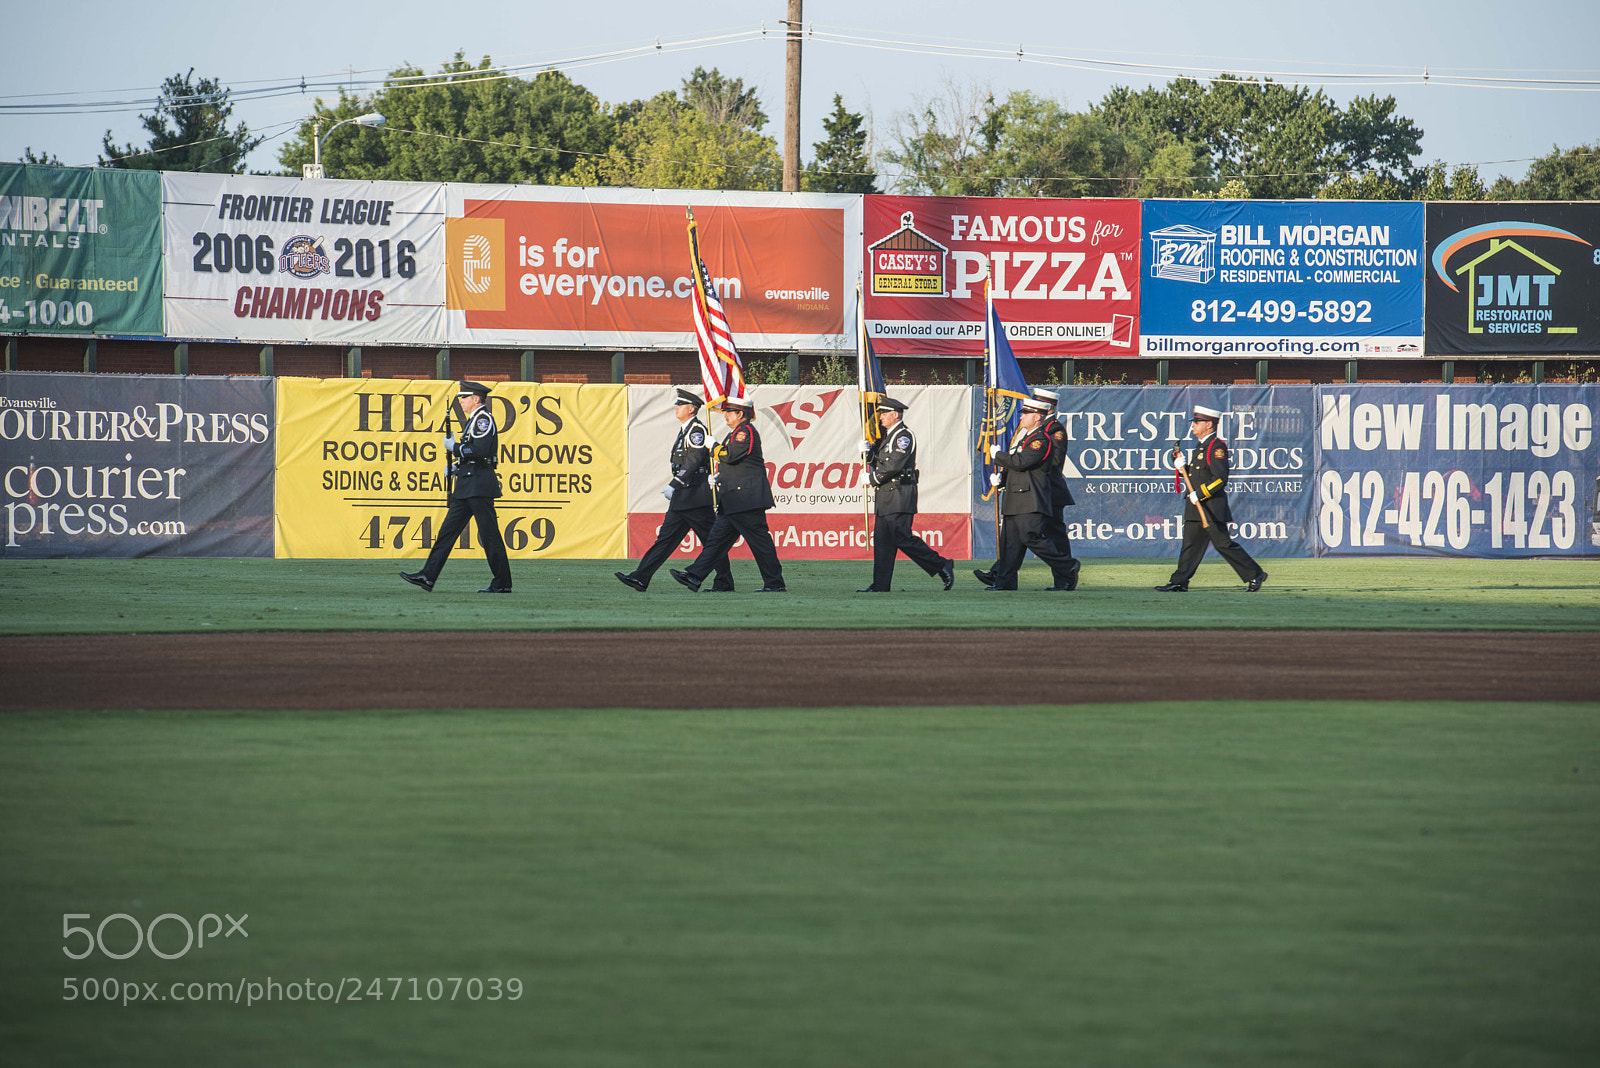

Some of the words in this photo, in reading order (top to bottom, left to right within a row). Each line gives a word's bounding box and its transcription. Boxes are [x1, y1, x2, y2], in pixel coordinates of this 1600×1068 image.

[218, 193, 314, 223] FRONTIER
[320, 199, 394, 226] LEAGUE
[951, 214, 1086, 243] FAMOUS
[1091, 219, 1123, 246] for
[1221, 224, 1271, 246] BILL
[1279, 224, 1390, 247] MORGAN
[193, 231, 275, 275] 2006
[278, 252, 331, 274] OTTERS
[334, 237, 416, 279] 2016
[519, 235, 544, 268] is
[553, 237, 600, 269] for
[878, 253, 938, 272] CASEY'S
[1220, 248, 1285, 267] ROOFING
[1289, 249, 1300, 266] &
[1304, 248, 1417, 267] CONSTRUCTION
[36, 273, 139, 292] Guaranteed
[878, 277, 912, 289] GENERAL
[914, 277, 938, 290] STORE
[952, 250, 1132, 300] PIZZA
[1220, 269, 1303, 283] RESIDENTIAL
[1314, 269, 1400, 283] COMMERCIAL
[519, 270, 742, 306] everyone.cm
[765, 287, 830, 301] evansville
[1477, 275, 1556, 306] JMT
[234, 285, 385, 321] CHAMPIONS
[797, 303, 830, 312] INDIANA
[1191, 299, 1372, 323] 812-499-5892
[1476, 309, 1553, 321] RESTORATION
[875, 323, 932, 336] Download
[935, 327, 955, 336] our
[957, 325, 982, 336] APP
[1010, 326, 1053, 338] ORDER
[1056, 326, 1106, 338] ONLINE!
[1488, 322, 1542, 334] SERVICES
[1146, 338, 1360, 355] billmorganroofing.com
[0, 396, 57, 409] Evansville
[1321, 394, 1424, 451] New
[1436, 394, 1592, 458] Image
[323, 441, 437, 463] ROOFING
[500, 444, 593, 465] NDOWS
[4, 453, 187, 500] courier
[322, 470, 383, 491] SIDING
[389, 472, 401, 492] &
[509, 473, 592, 494] GUTTERS
[1086, 482, 1096, 494] &
[1099, 481, 1187, 494] ORTHOPAED
[1224, 481, 1263, 494] GENT
[1266, 481, 1303, 494] CARE
[795, 494, 807, 503] to
[809, 495, 836, 506] grow
[838, 495, 863, 506] your
[1320, 470, 1575, 550] 812-426-1423
[4, 502, 187, 548] press.com
